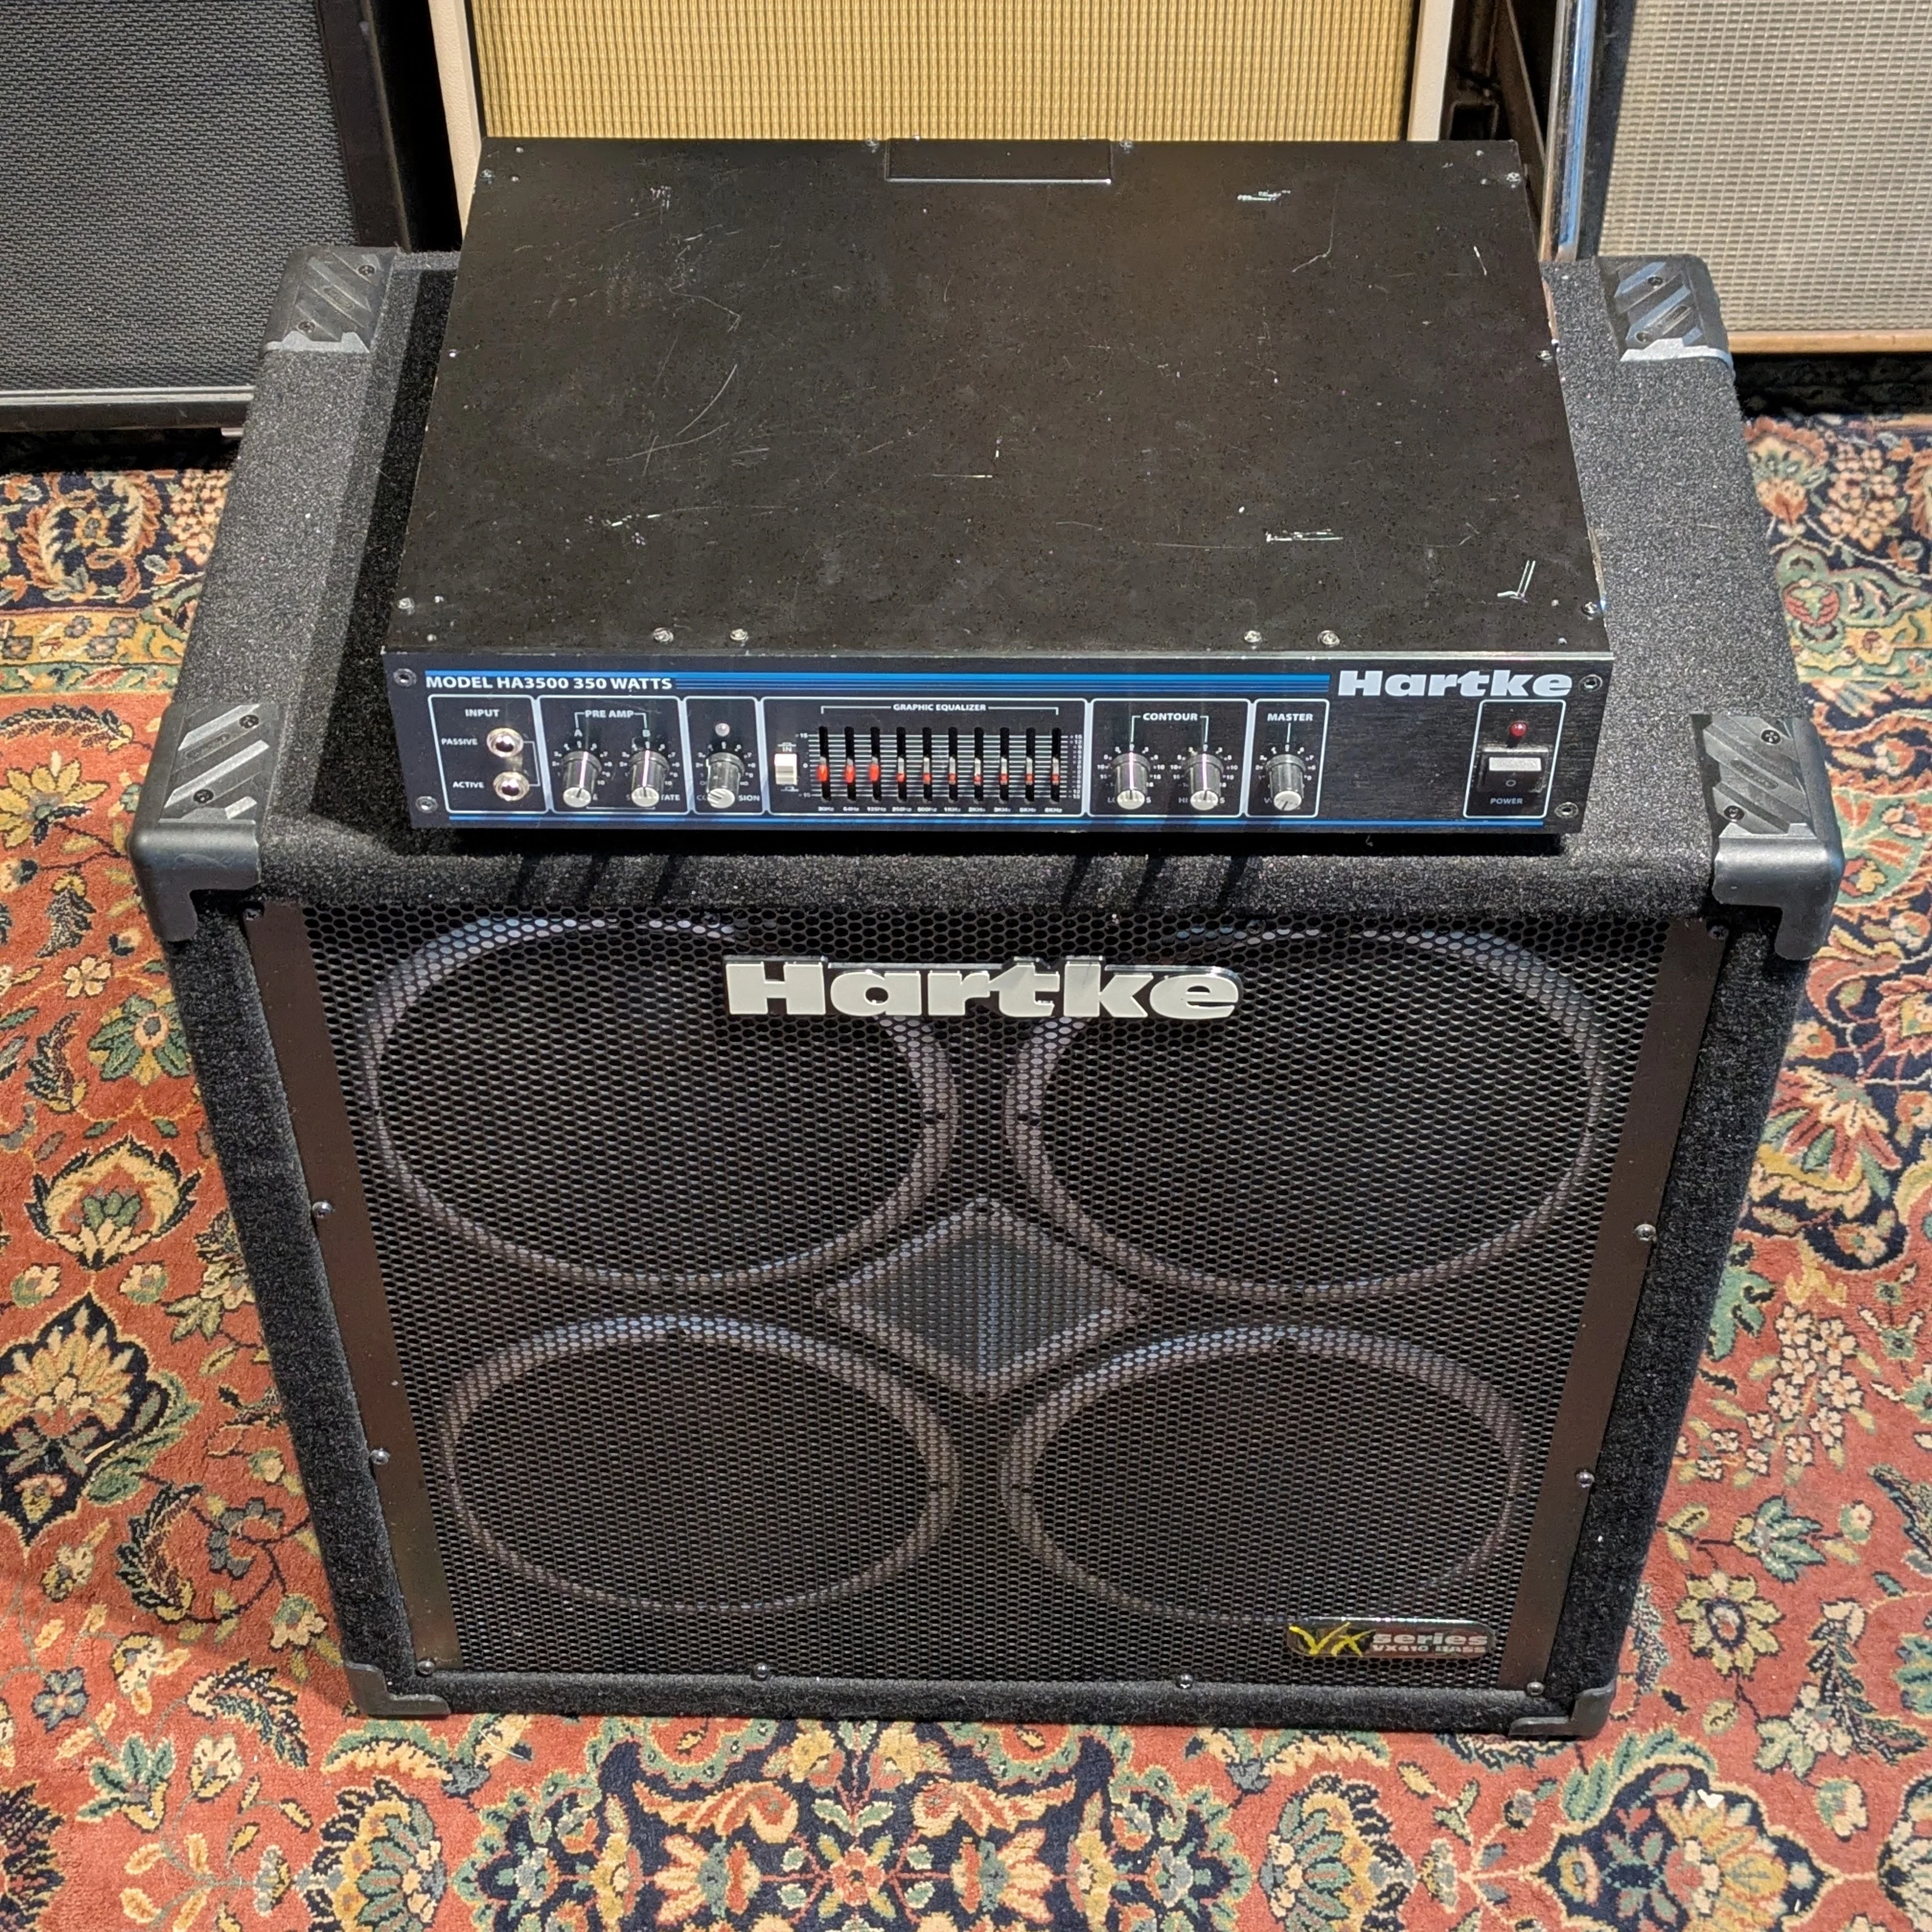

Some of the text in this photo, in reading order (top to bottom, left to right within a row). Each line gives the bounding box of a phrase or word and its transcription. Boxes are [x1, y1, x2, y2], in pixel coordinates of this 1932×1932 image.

[426, 676, 672, 690] MODEL HA3500 350 WATTS
[1338, 670, 1573, 697] Hartke
[585, 709, 634, 718] PRE AMP
[725, 960, 1240, 1019] Hartke
[1289, 1621, 1488, 1657] VX series
